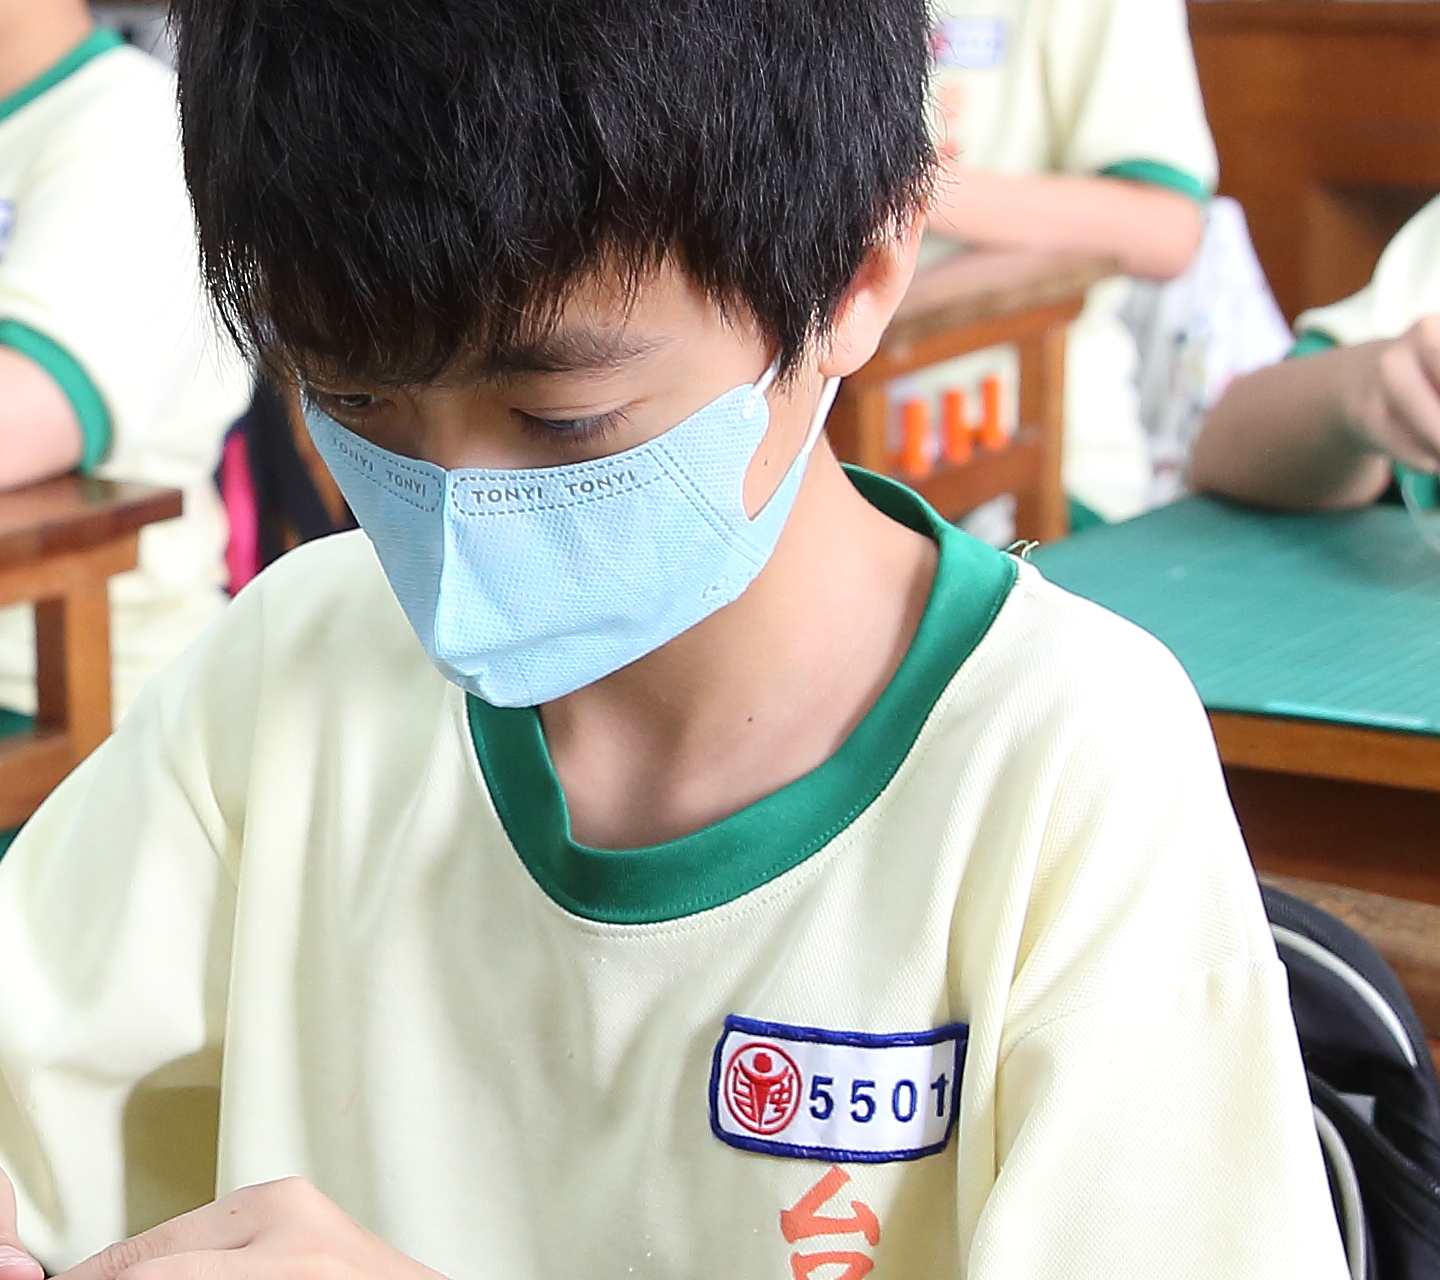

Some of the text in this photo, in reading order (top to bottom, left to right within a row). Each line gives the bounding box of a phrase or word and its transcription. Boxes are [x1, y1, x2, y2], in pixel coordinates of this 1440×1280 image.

[386, 469, 426, 498] TONYI
[472, 470, 635, 505] TONYI TONYI
[808, 1072, 951, 1123] 5501
